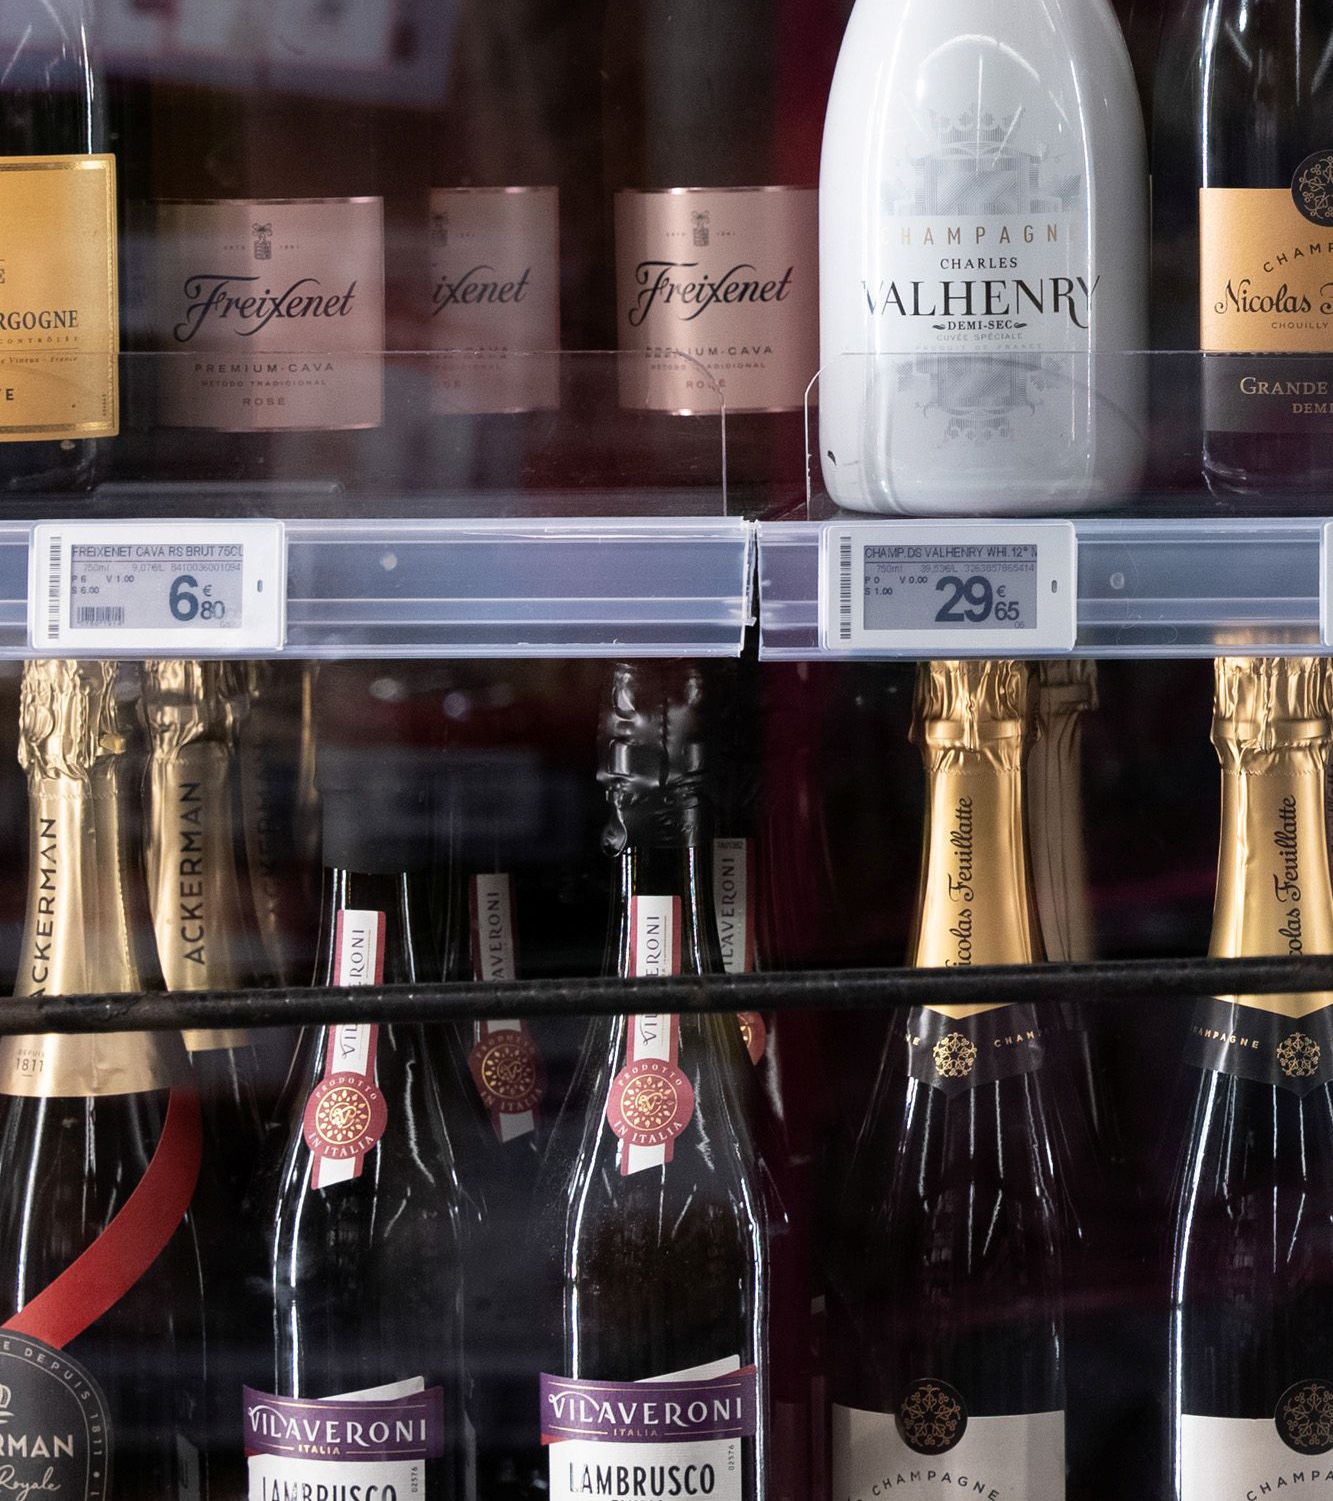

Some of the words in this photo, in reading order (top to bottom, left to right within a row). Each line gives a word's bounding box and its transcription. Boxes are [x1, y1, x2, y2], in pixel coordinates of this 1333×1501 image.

[940, 257, 1018, 269] CHARLES
[174, 274, 358, 342] Freixenet
[628, 261, 794, 327] Freixenet
[861, 276, 1101, 329] VALHENRY
[1214, 280, 1311, 316] Nicolas
[948, 320, 1013, 330] DEMI-SEC
[1240, 377, 1328, 395] GRANDE
[72, 547, 133, 557] FREIXENET
[136, 547, 165, 557] CAVA
[169, 575, 199, 621] 6
[934, 575, 994, 622] 29
[995, 601, 1020, 620] 65
[948, 795, 974, 903] Feuillatte
[1273, 793, 1302, 903] Feuillatte
[180, 782, 206, 965] ACKERMAN
[16, 1057, 44, 1072] 1811
[618, 1063, 683, 1088] PRODOTTO
[249, 1405, 427, 1447] VILAVERONI
[550, 1392, 743, 1426] VILAVERONI
[614, 1427, 658, 1437] ITALIA
[298, 1444, 341, 1456] ITALIA
[569, 1461, 716, 1494] LAMBRUSCO
